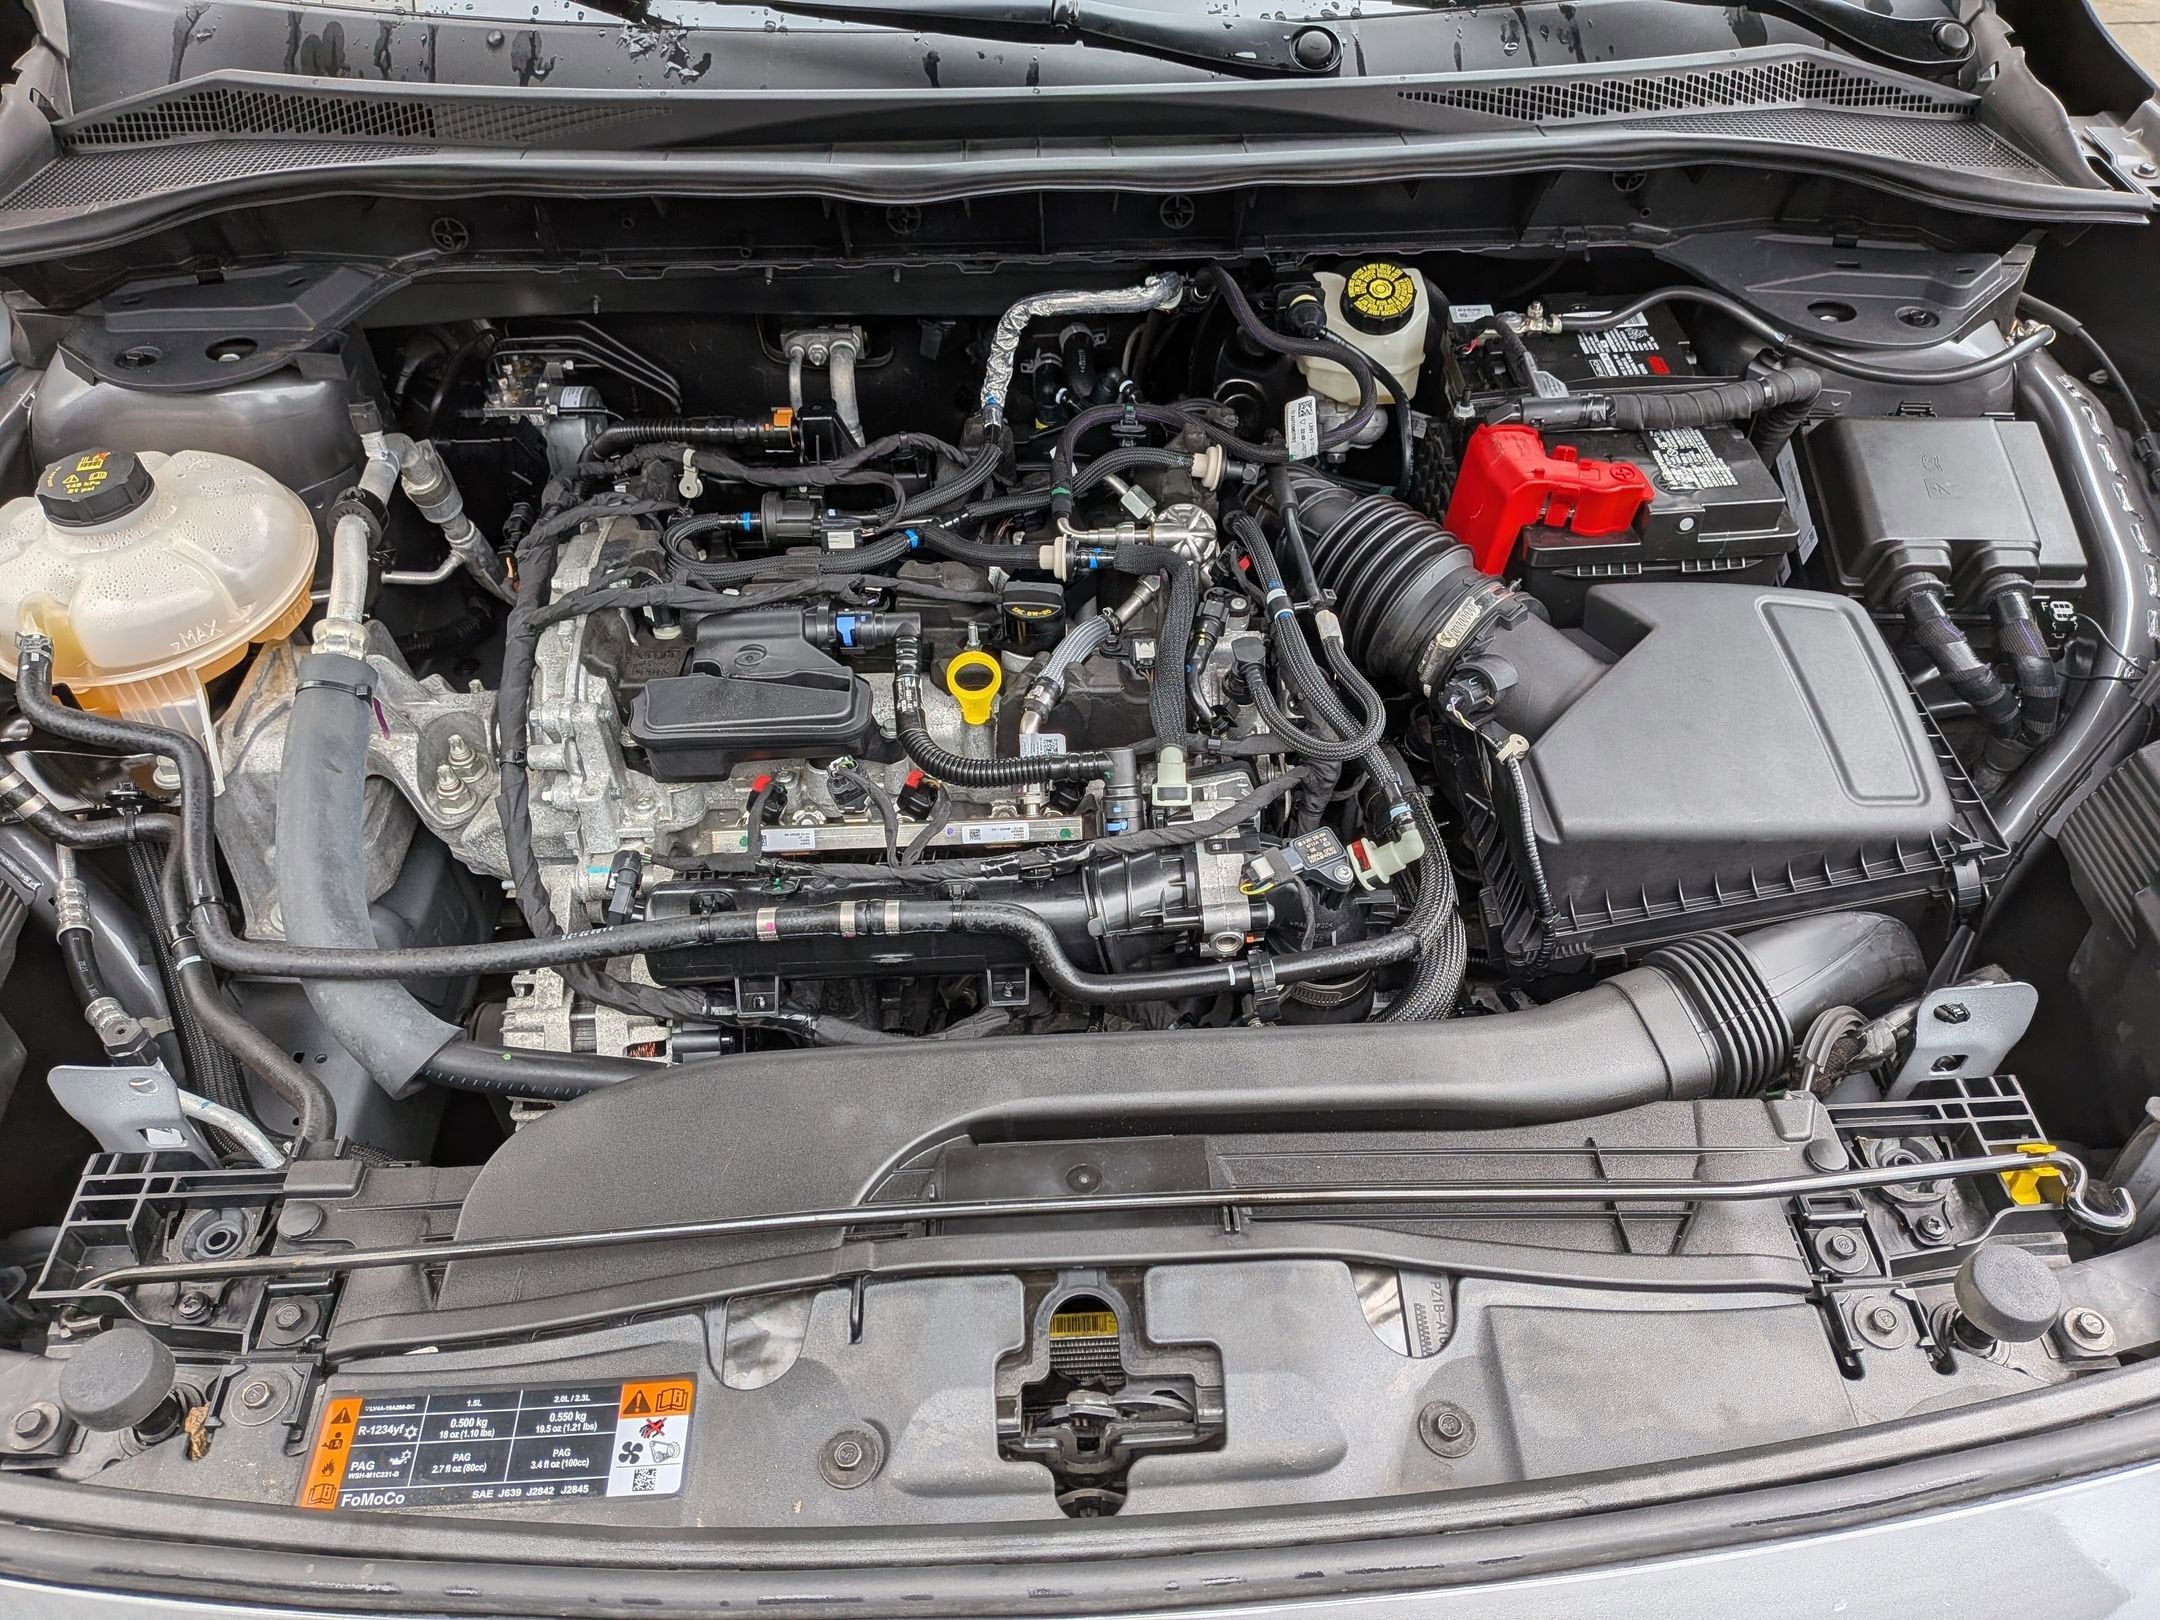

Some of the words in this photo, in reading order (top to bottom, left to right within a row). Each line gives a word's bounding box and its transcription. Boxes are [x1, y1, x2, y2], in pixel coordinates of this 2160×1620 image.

[178, 619, 223, 648] MAX
[466, 1399, 482, 1407] 1.5L
[553, 1395, 570, 1403] 2.0L
[574, 1393, 591, 1402] 2.3L
[450, 1417, 475, 1428] 0.500
[476, 1417, 488, 1429] kg
[549, 1411, 574, 1422] 0.550
[575, 1411, 587, 1423] kg
[357, 1424, 405, 1436] R-1234yf
[535, 1424, 551, 1433] 19.5
[552, 1425, 562, 1433] oz
[563, 1423, 581, 1433] (1.21
[582, 1421, 598, 1432] lbs)
[439, 1430, 449, 1439] 18
[460, 1429, 479, 1439] (1.10
[480, 1428, 495, 1438] lbs)
[452, 1453, 472, 1462] PAG
[552, 1448, 571, 1457] PAG
[350, 1461, 376, 1471] PAG
[431, 1464, 445, 1474] 2.7
[445, 1464, 452, 1473] fl
[452, 1465, 463, 1473] oz
[463, 1462, 487, 1474] (80cc)
[530, 1460, 543, 1469] 3.4
[561, 1458, 590, 1469] (100cc)
[472, 1489, 494, 1499] SAE
[498, 1488, 522, 1498] J639
[526, 1486, 555, 1496] J2842
[560, 1484, 589, 1495] J2845
[341, 1491, 406, 1507] FoMoCo
